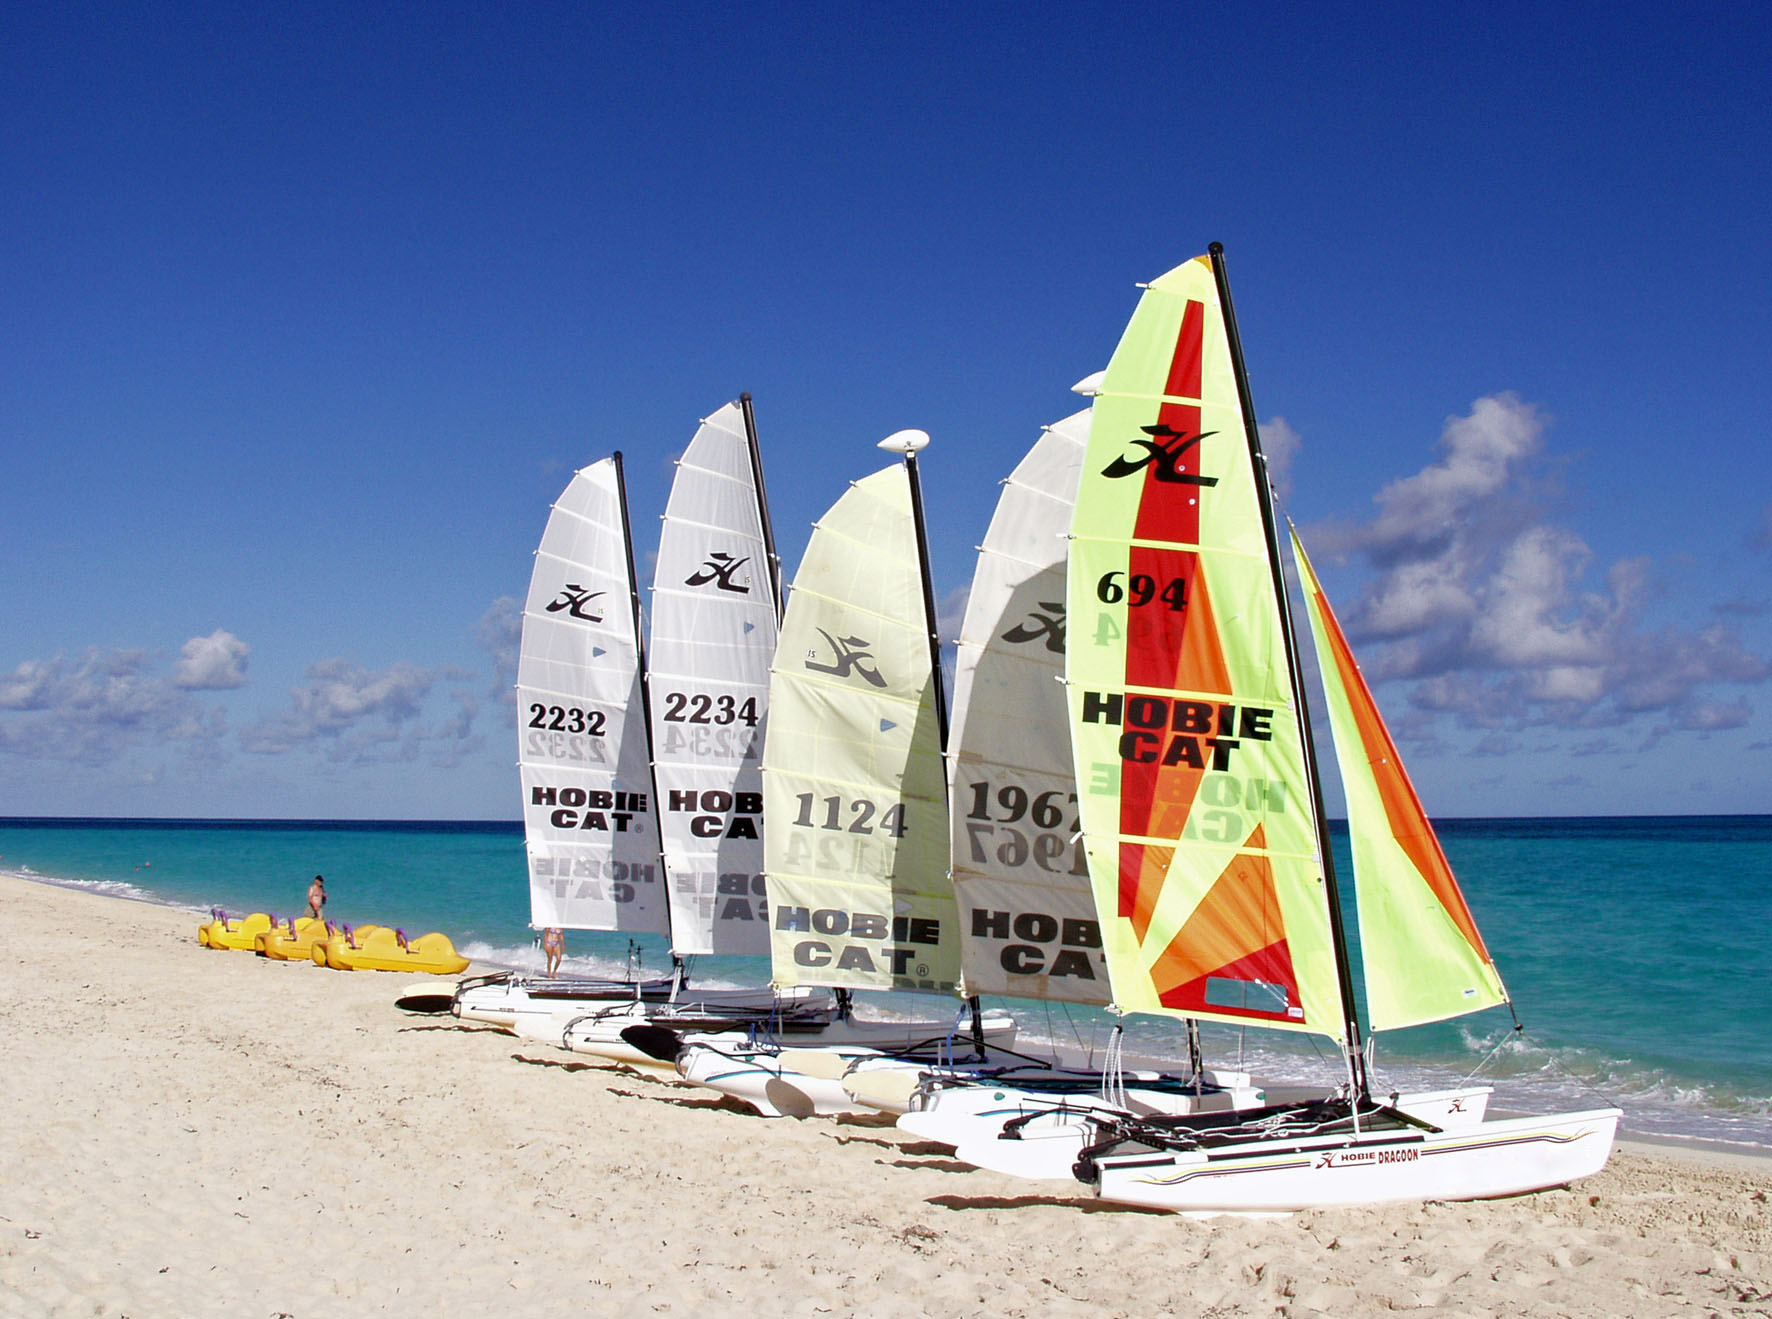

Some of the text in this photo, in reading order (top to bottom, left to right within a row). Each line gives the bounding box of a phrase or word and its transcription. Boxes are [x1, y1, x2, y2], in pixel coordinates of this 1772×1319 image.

[1096, 571, 1188, 612] 694
[528, 703, 606, 737] 2232
[663, 692, 759, 727] 2234
[1082, 691, 1274, 741] HOBIE
[1118, 731, 1240, 772] CAT
[532, 787, 647, 813] HOBIE
[792, 792, 909, 838] 1124
[551, 809, 633, 833] CAT
[690, 815, 763, 840] CA
[776, 905, 940, 946] HOBIE
[793, 941, 915, 975] CAT
[1001, 944, 1106, 981] CA
[1341, 1148, 1418, 1164] HOBIE DRAGOON
